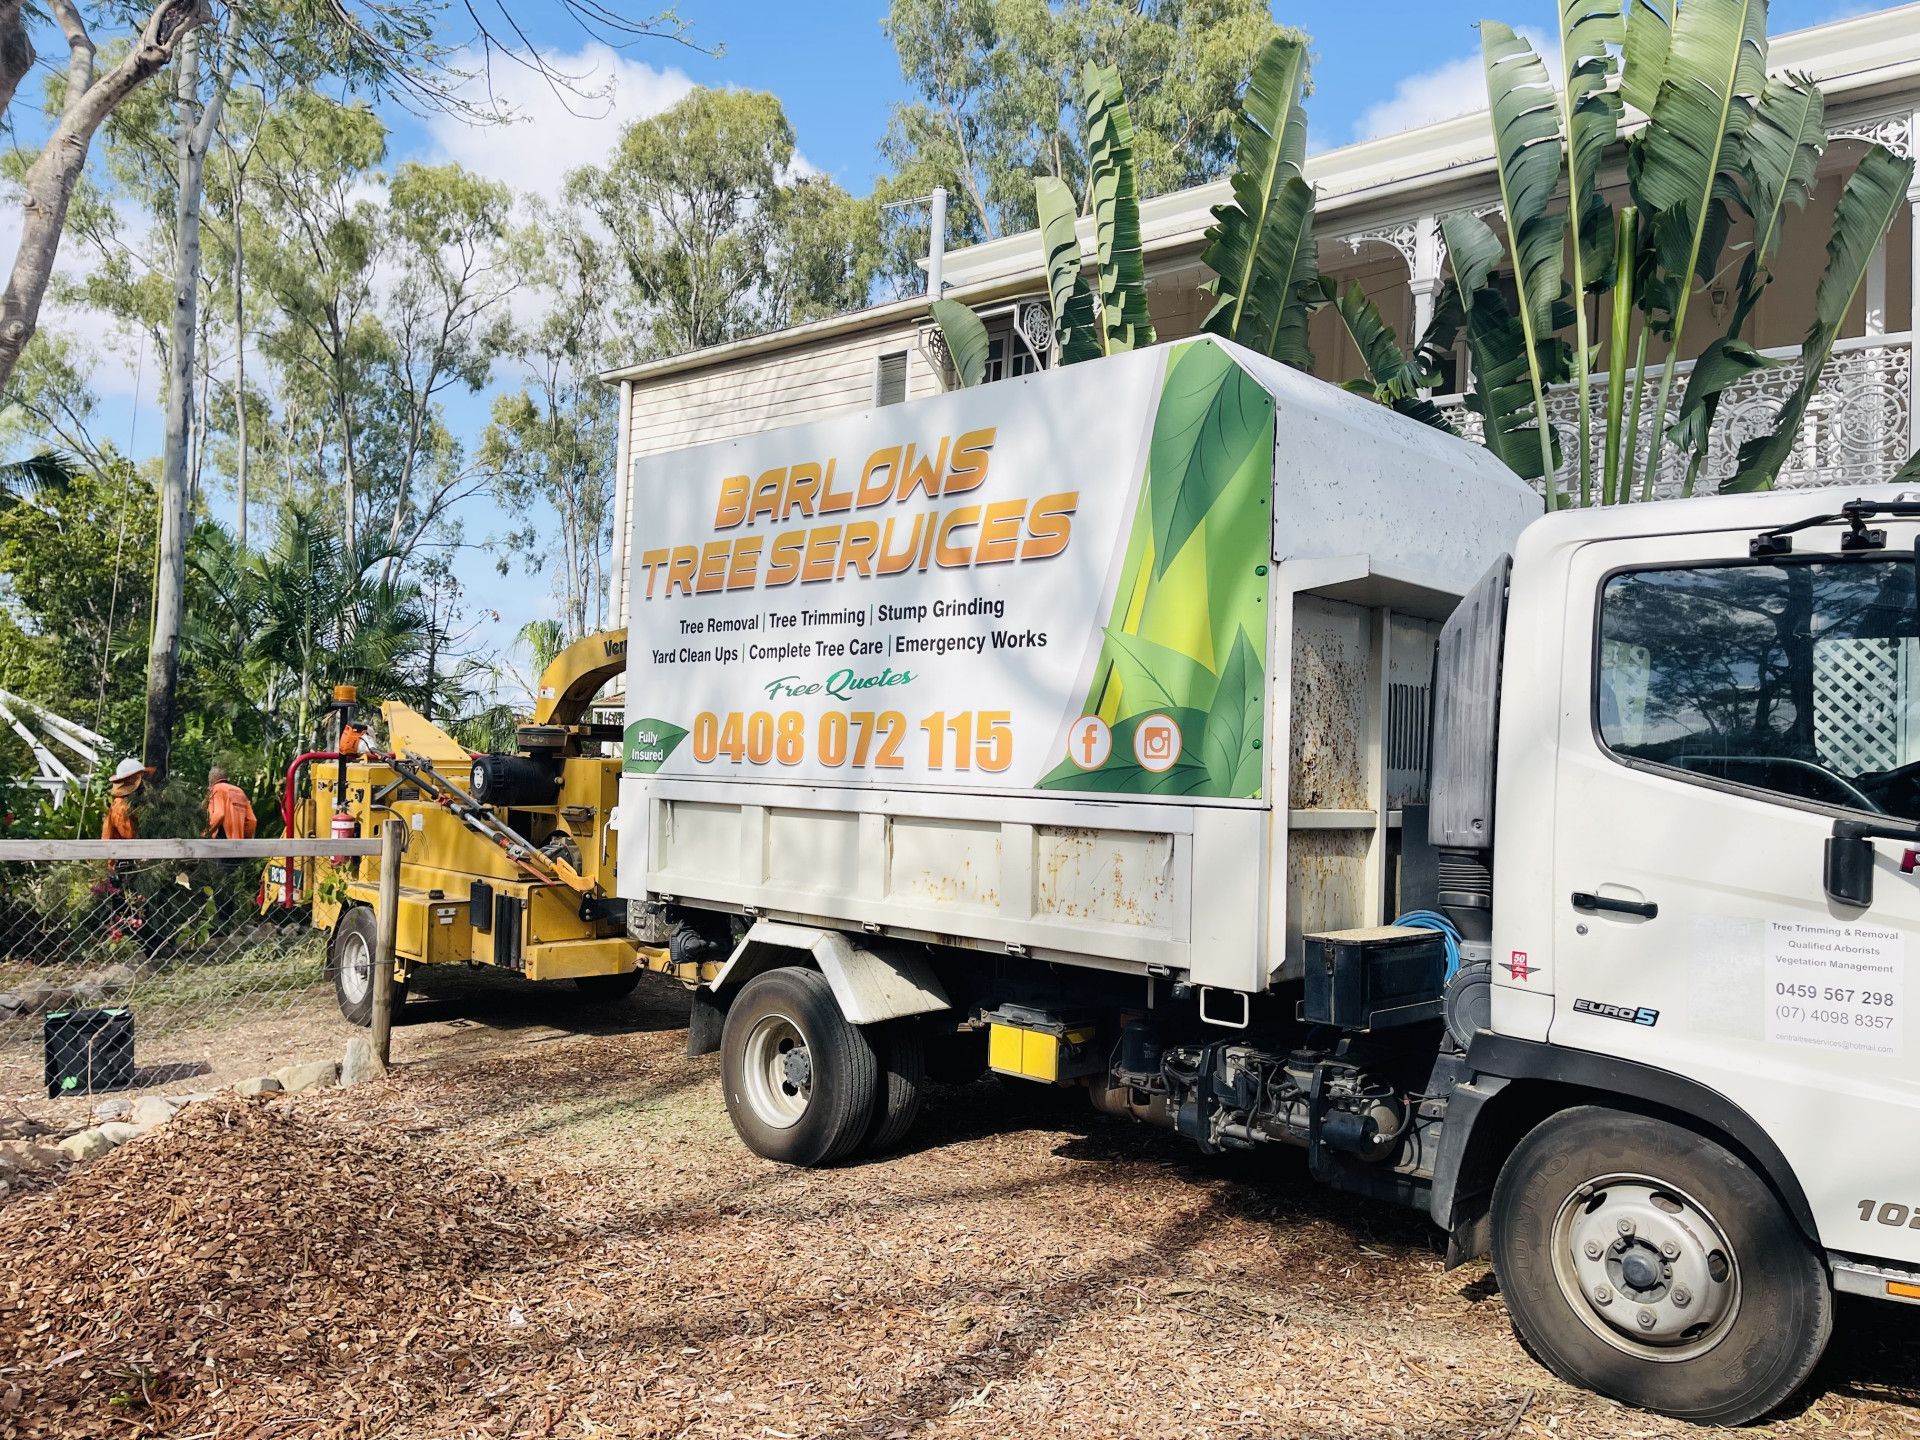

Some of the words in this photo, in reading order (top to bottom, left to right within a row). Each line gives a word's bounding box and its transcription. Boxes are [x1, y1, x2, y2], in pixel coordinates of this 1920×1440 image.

[714, 427, 998, 531] BARLOWS
[642, 536, 764, 599] TREE
[680, 619, 703, 635] Tree
[707, 615, 759, 633] Removal
[769, 612, 797, 628] Tree
[801, 608, 865, 627] Trimming
[878, 604, 927, 623] Stump
[933, 597, 1005, 618] Grinding
[603, 639, 627, 657] Ver
[652, 648, 676, 664] Yard
[679, 647, 711, 662] Clean
[715, 647, 738, 665] Ups
[750, 643, 811, 662] Complete
[815, 641, 845, 656] Tree
[849, 638, 883, 656] Care
[895, 635, 986, 655] Emergency
[991, 630, 1047, 648] Works
[764, 675, 823, 701] Free
[824, 667, 918, 701] Quotes
[638, 731, 658, 746] Fully
[693, 710, 805, 765] 0408
[817, 710, 907, 769] 072
[920, 710, 1013, 772] 115
[632, 748, 664, 761] Insured
[1772, 922, 1793, 931] Tree
[1795, 924, 1841, 937] Trimming
[1844, 928, 1851, 936] &
[1854, 929, 1899, 940] Removal
[1513, 953, 1526, 963] 50
[1788, 940, 1832, 951] Qualified
[1834, 944, 1880, 955] Arborists
[1775, 955, 1827, 967] Vegetation
[1829, 960, 1893, 973] Management
[1776, 982, 1817, 999] 0459
[1824, 987, 1855, 1003] 567
[1861, 991, 1894, 1007] 298
[1775, 1005, 1806, 1022] (07)
[1810, 1009, 1849, 1025] 4098
[1855, 1013, 1894, 1029] 8357
